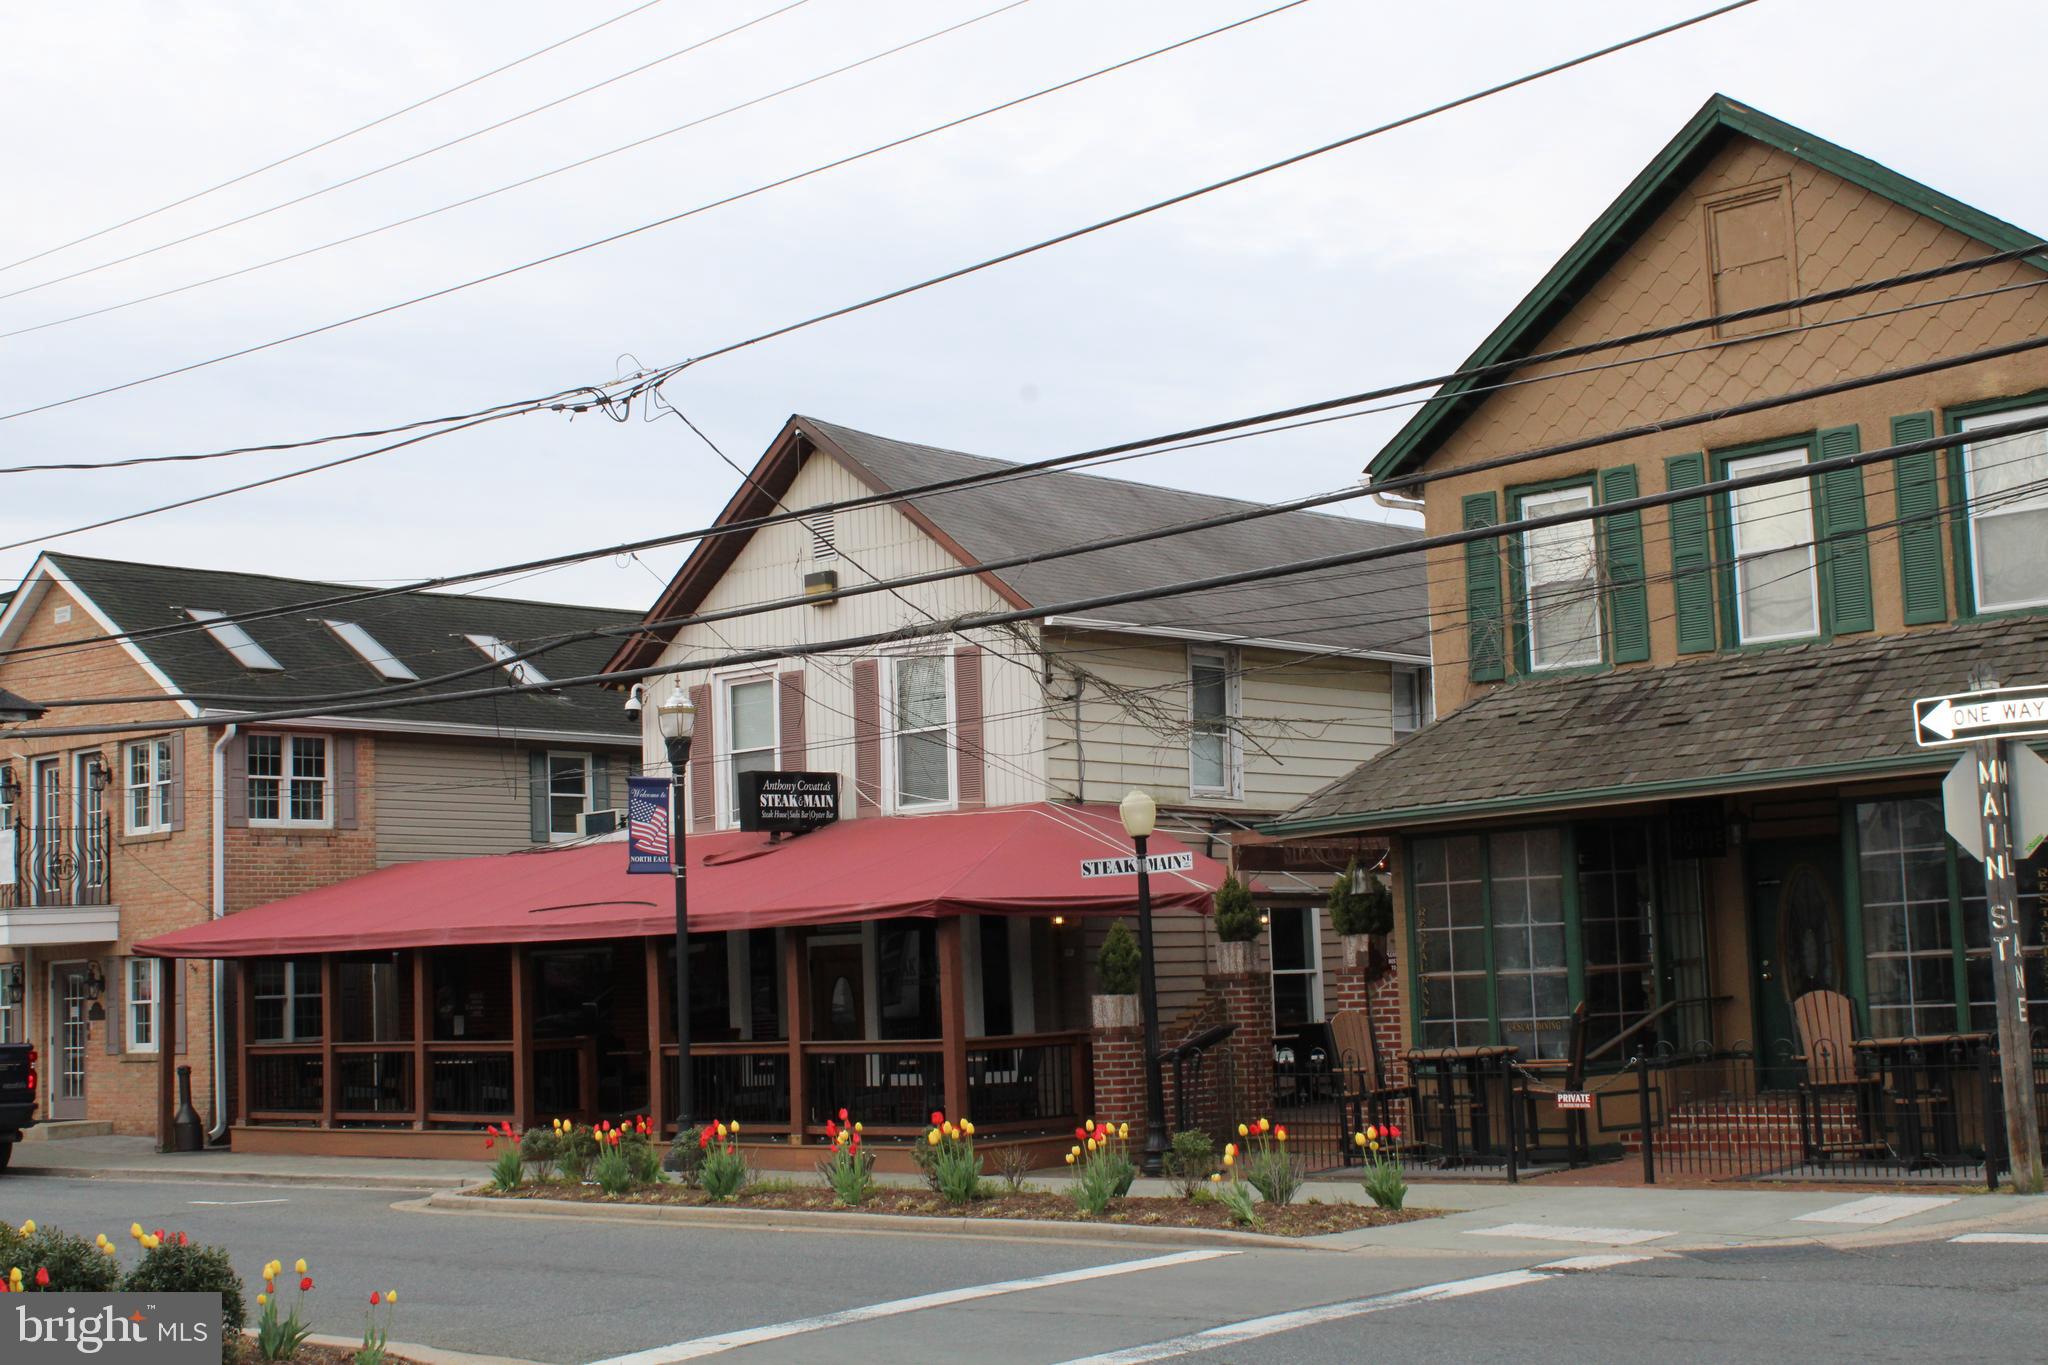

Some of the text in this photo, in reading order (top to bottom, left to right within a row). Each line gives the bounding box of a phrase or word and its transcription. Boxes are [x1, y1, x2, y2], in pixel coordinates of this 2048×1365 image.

[1954, 701, 2045, 725] ONE WAY
[631, 788, 659, 798] Welcome
[763, 779, 832, 793] Anthony Covatta's
[760, 794, 798, 807] STEAK
[803, 794, 834, 807] MAIN
[1082, 859, 1136, 876] STEAK
[1147, 855, 1182, 871] MAIN
[1978, 759, 2010, 961] MAIN ST
[1998, 760, 2028, 1022] MILL LANE
[1557, 1094, 1590, 1103] PRIVATE
